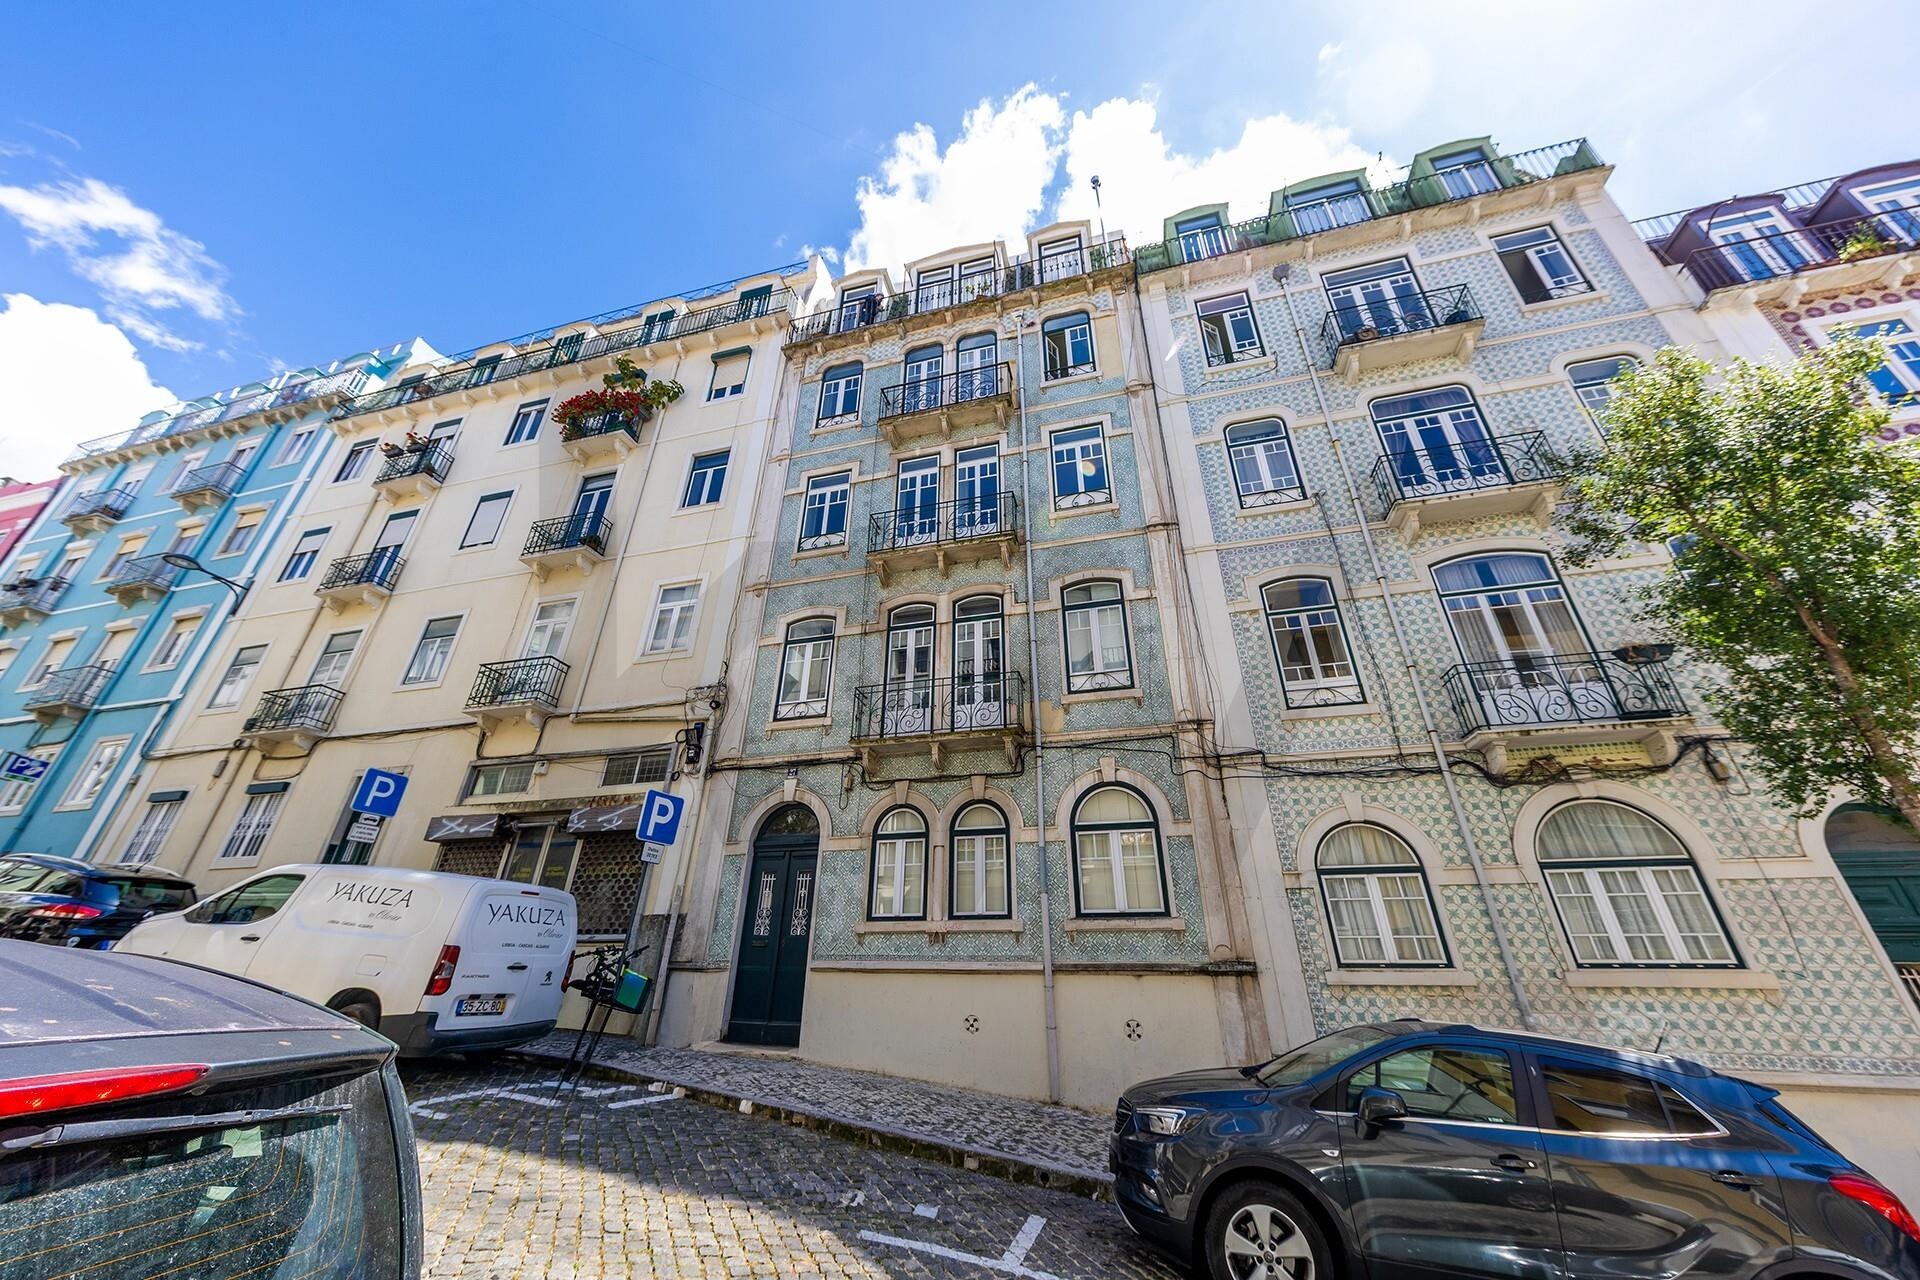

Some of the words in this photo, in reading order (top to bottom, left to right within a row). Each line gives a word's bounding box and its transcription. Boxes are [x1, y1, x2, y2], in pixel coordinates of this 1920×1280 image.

[11, 758, 30, 769] P
[365, 775, 395, 807] P
[646, 796, 674, 836] P
[327, 882, 413, 908] YAKUZA
[488, 903, 565, 927] YAKUZA
